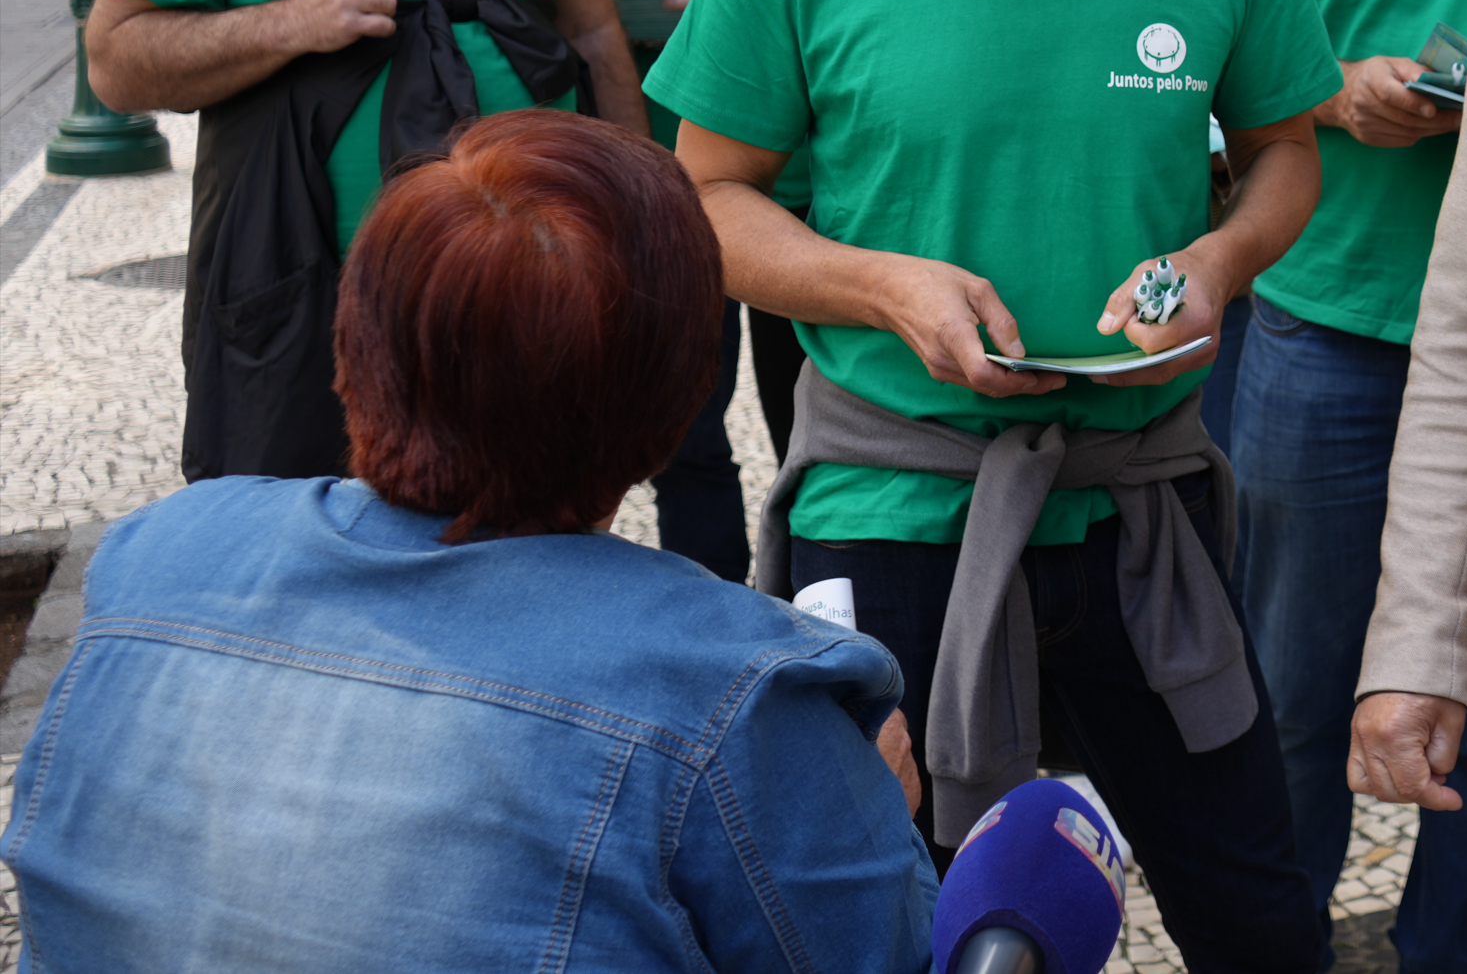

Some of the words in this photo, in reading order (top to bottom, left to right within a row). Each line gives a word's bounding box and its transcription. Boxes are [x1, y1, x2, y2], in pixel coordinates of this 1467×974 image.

[1107, 71, 1154, 89] Juntos
[1157, 74, 1183, 94] pelo
[1185, 75, 1208, 92] Povo
[825, 608, 853, 621] ilhas
